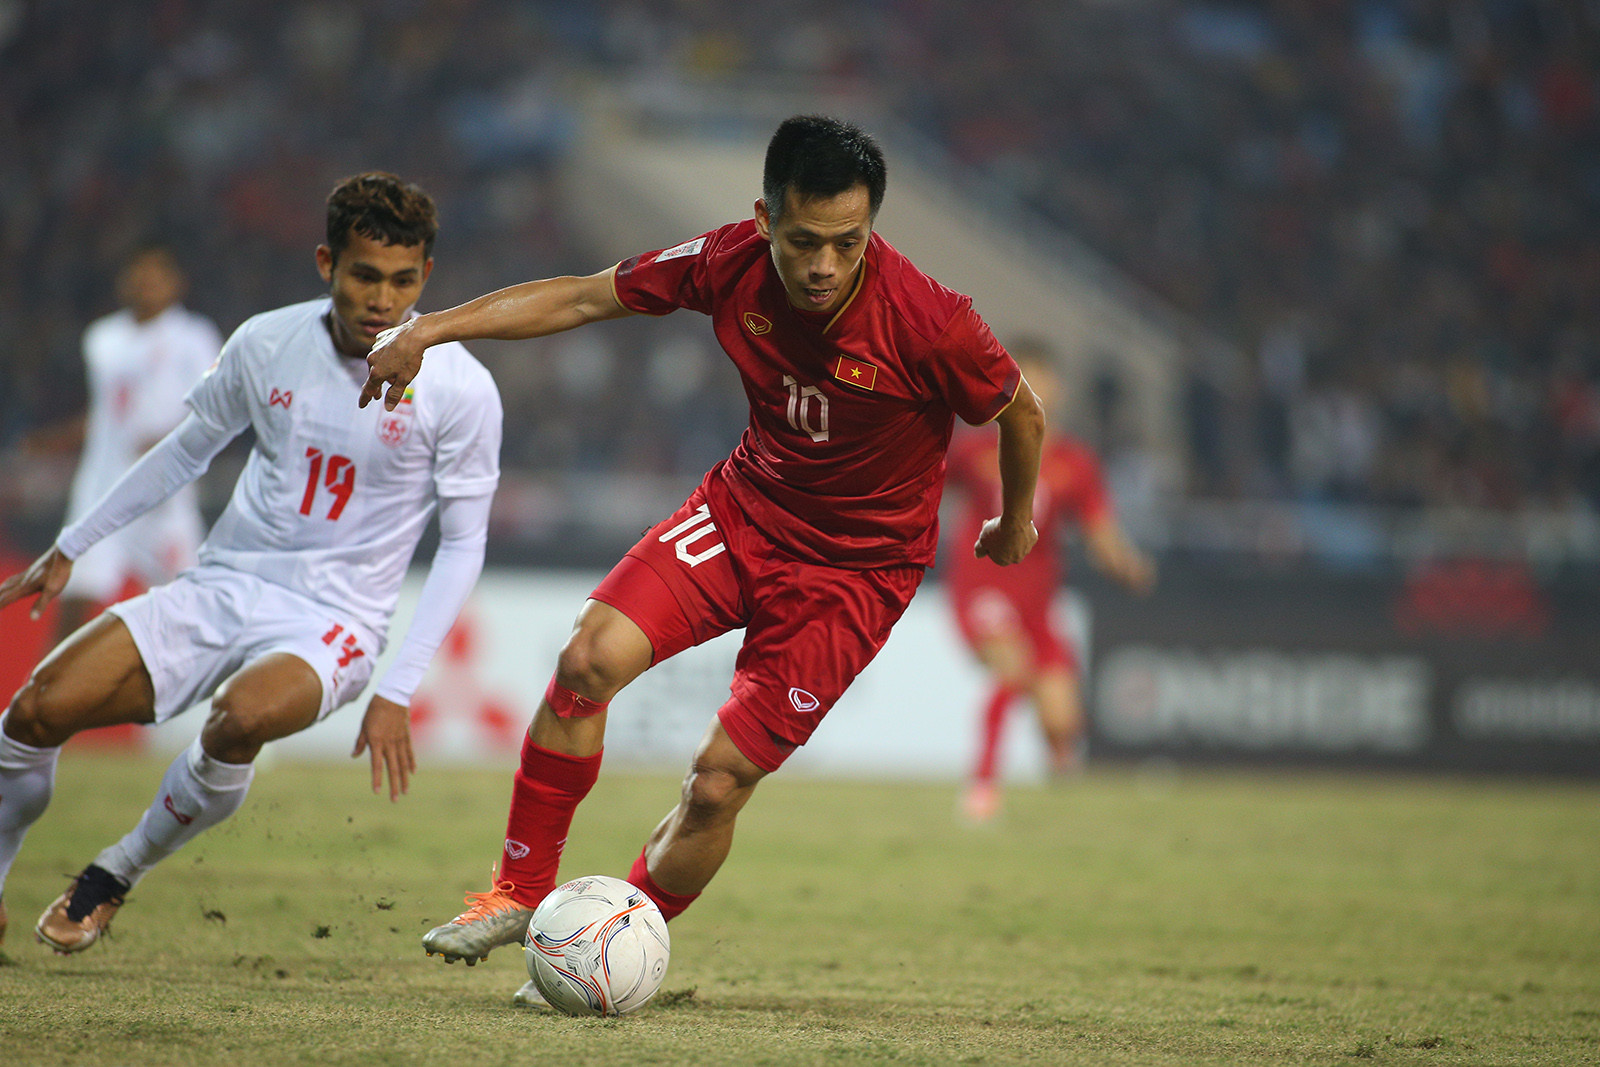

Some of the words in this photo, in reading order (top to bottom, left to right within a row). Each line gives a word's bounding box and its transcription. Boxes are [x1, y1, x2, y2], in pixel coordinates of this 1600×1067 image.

[782, 374, 829, 443] 10
[299, 446, 356, 522] 19
[658, 503, 726, 568] 10
